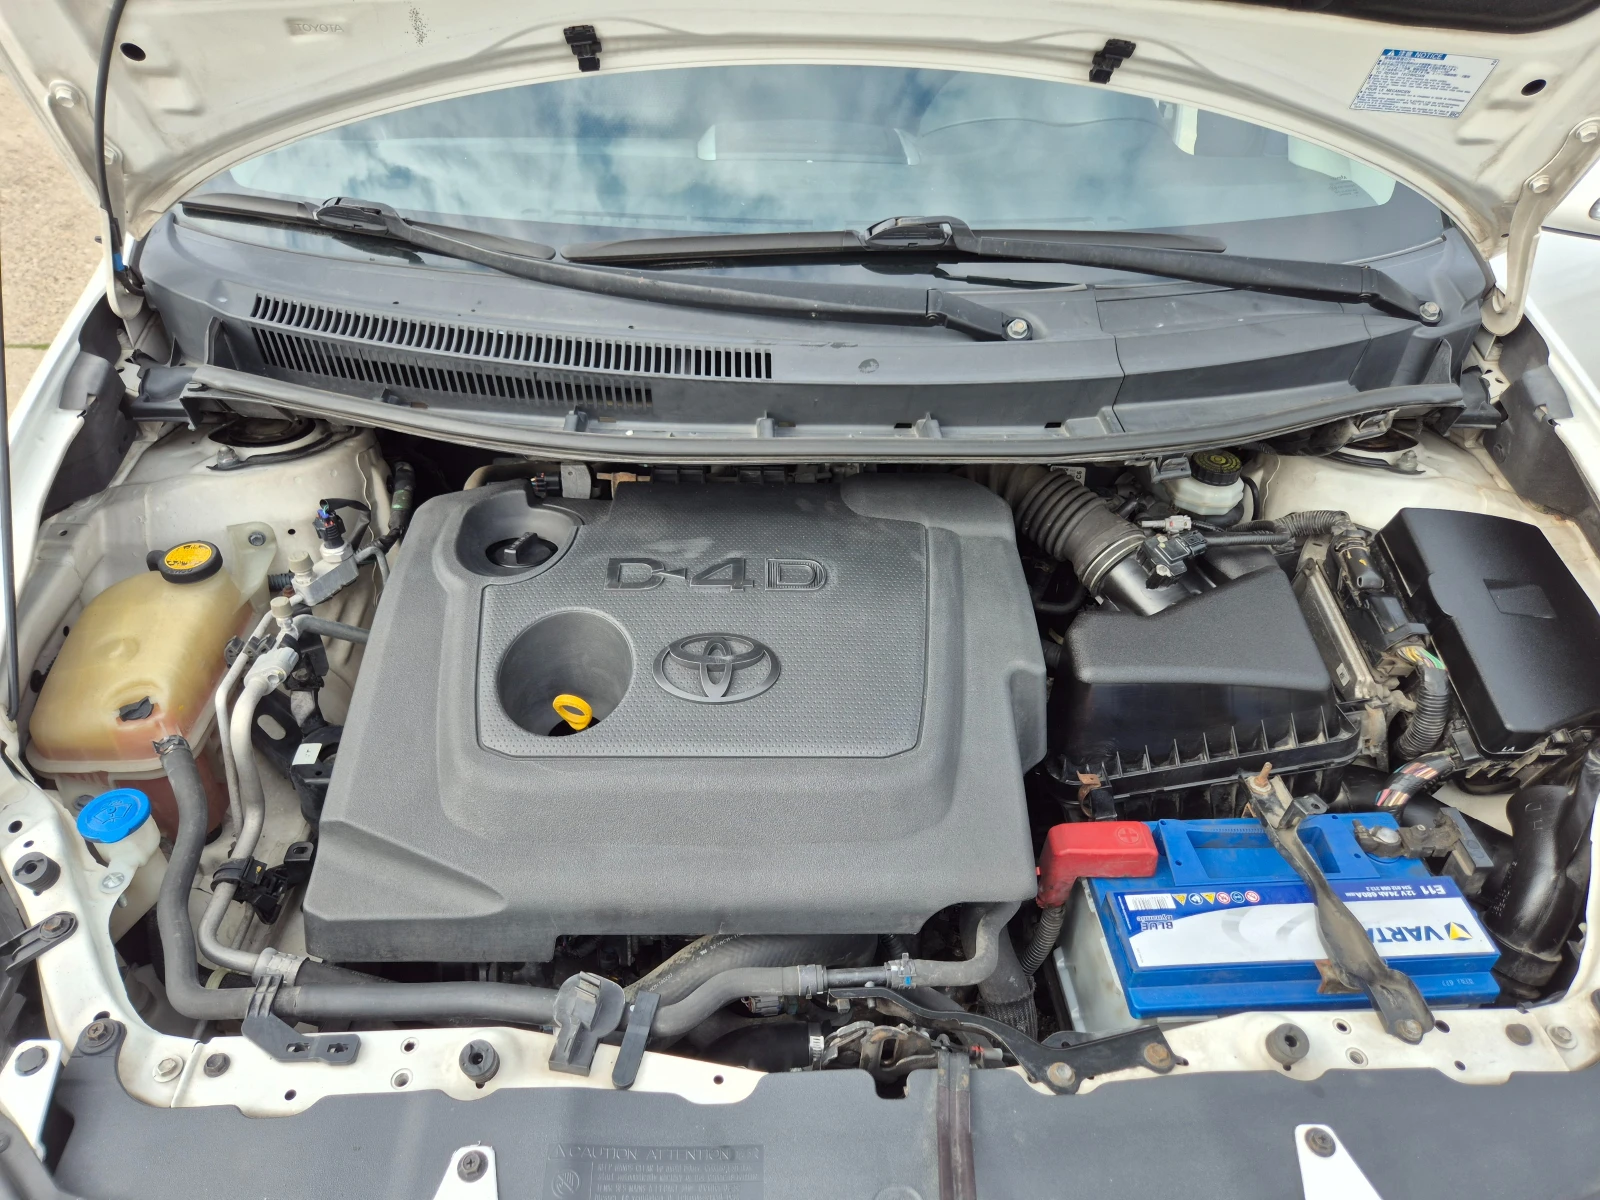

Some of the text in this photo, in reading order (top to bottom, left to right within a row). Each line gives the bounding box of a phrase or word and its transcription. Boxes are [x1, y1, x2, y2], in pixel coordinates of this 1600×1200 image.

[295, 23, 345, 33] TOYOTA
[1414, 51, 1443, 60] NOTICE
[1419, 884, 1447, 895] E11
[1141, 921, 1174, 931] BLUE
[568, 1146, 637, 1160] CAUTION
[645, 1148, 729, 1160] ATTENTION
